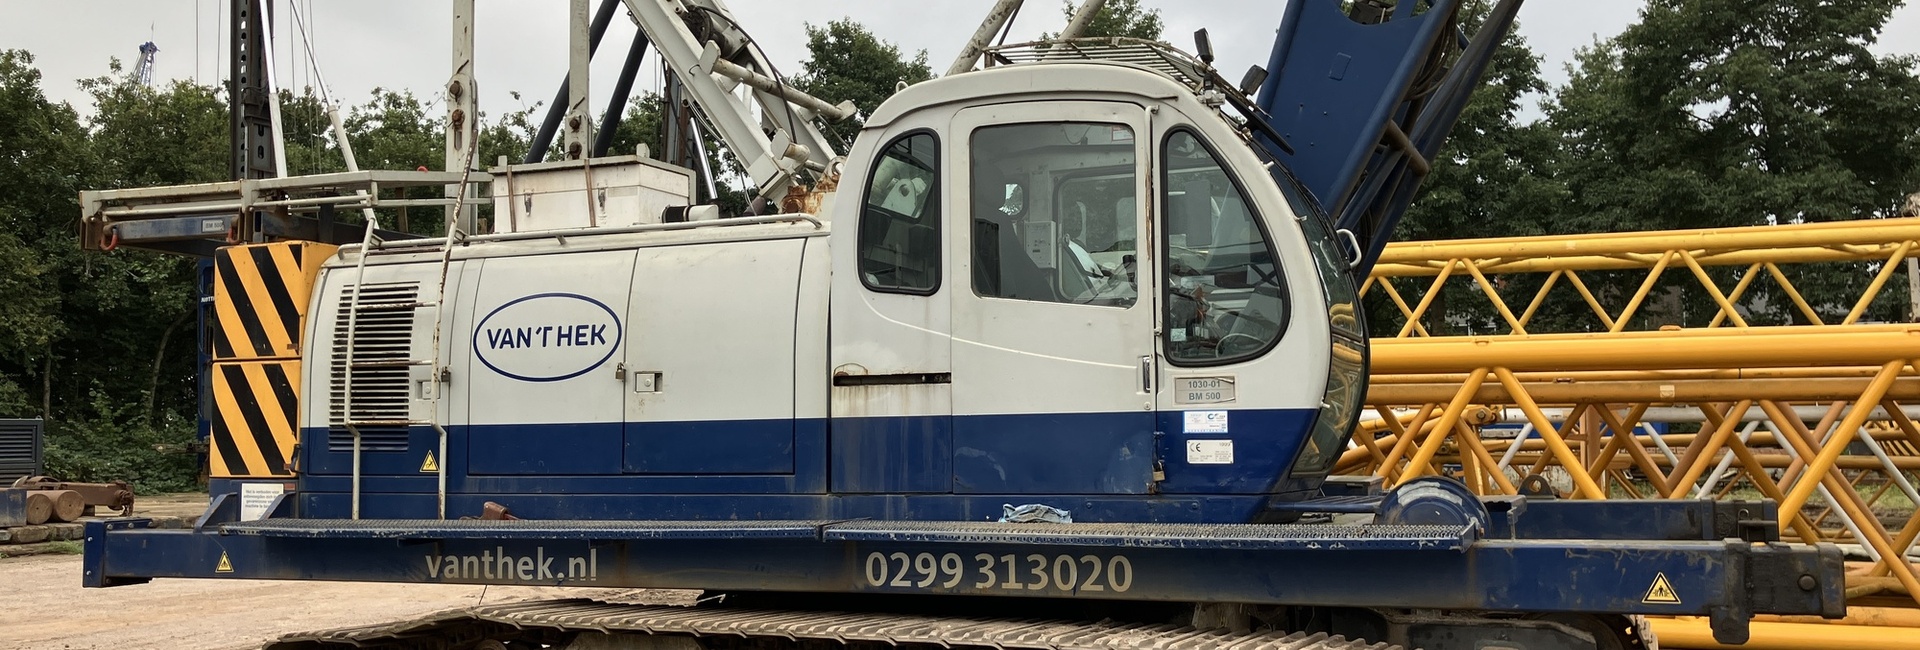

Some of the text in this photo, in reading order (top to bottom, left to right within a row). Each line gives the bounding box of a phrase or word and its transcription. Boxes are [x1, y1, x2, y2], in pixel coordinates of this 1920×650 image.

[557, 324, 607, 347] HEK
[1189, 392, 1221, 400] BM 500
[425, 546, 597, 582] vanthek.nl
[865, 551, 1134, 593] 0299 313020
